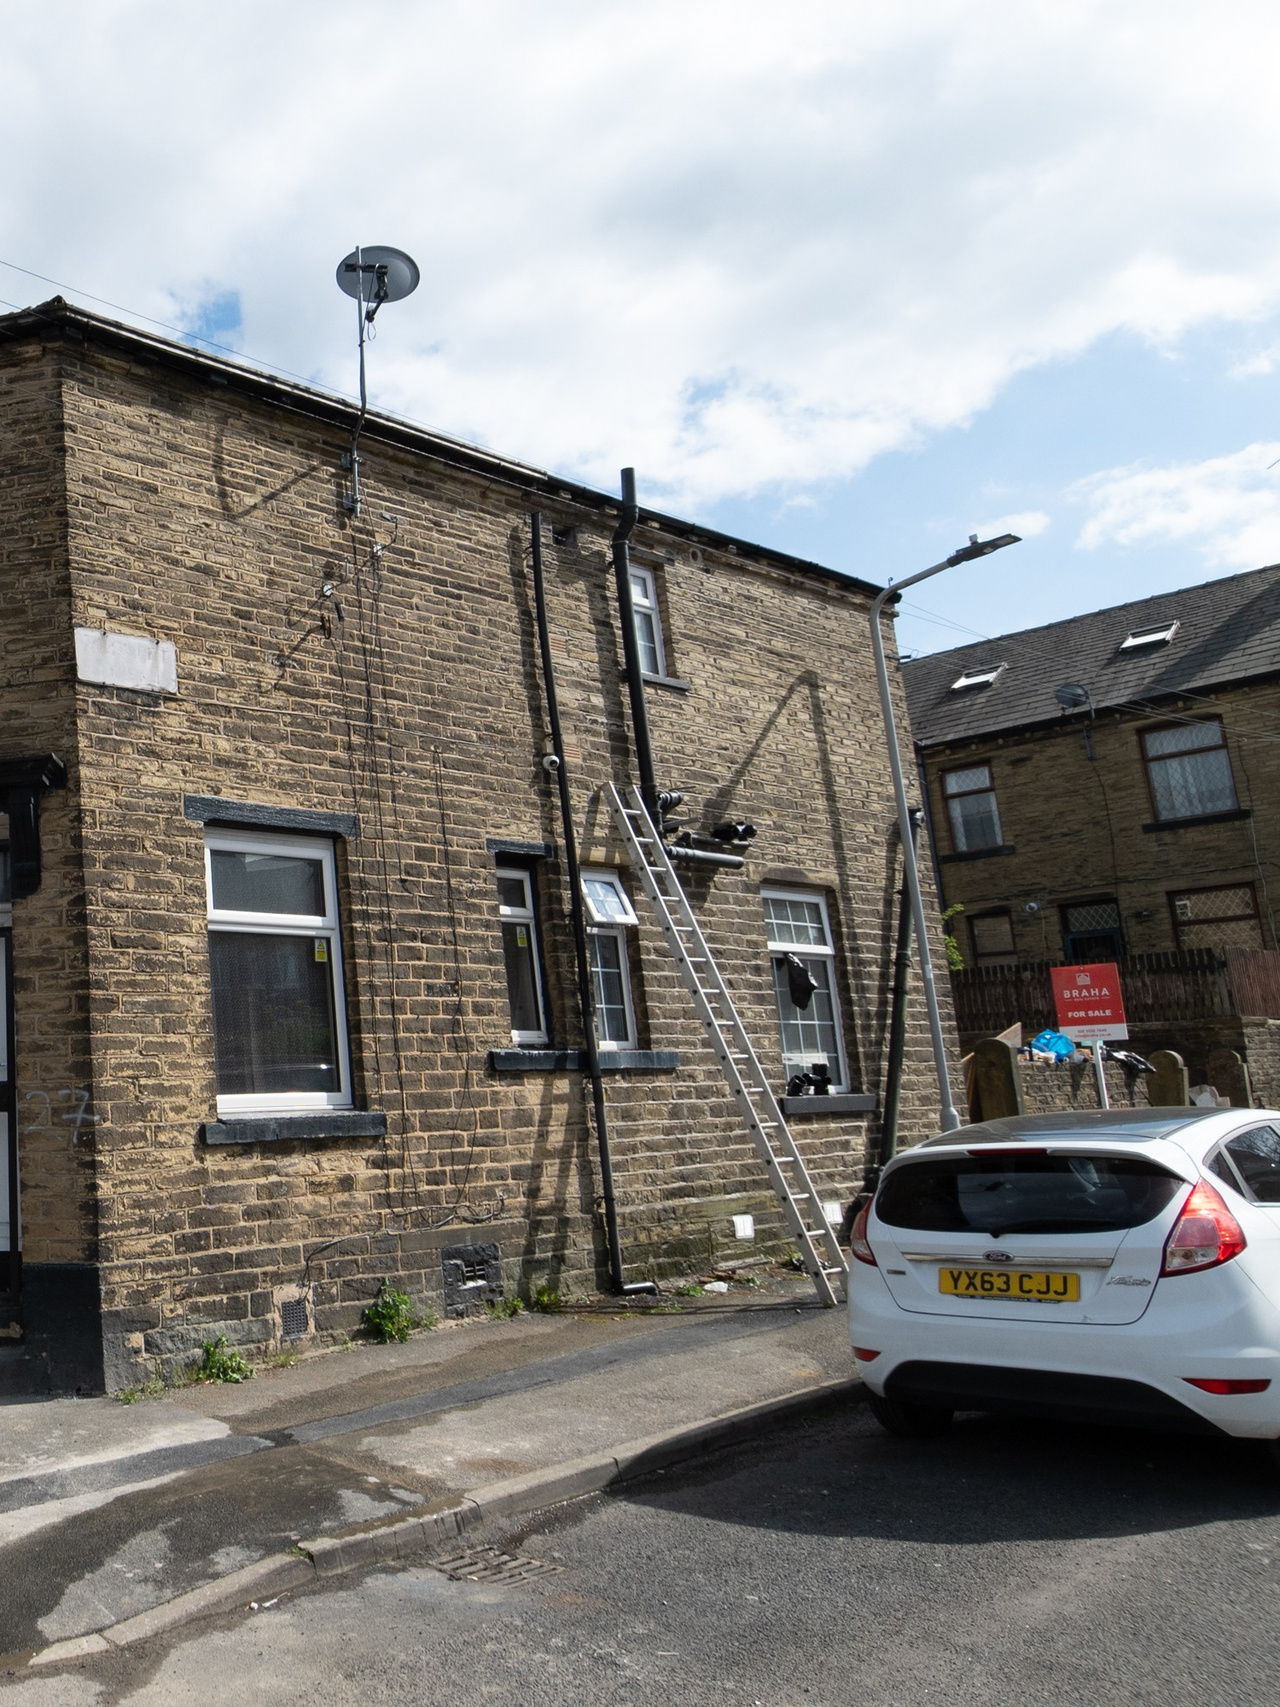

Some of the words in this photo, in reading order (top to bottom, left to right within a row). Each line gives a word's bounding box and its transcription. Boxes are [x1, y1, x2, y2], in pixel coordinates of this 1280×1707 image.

[1063, 987, 1110, 999] BRAHA
[1087, 1009, 1112, 1017] SALE
[25, 1089, 101, 1145] 27
[948, 1270, 1011, 1293] YX63
[1018, 1273, 1068, 1296] CJJ
